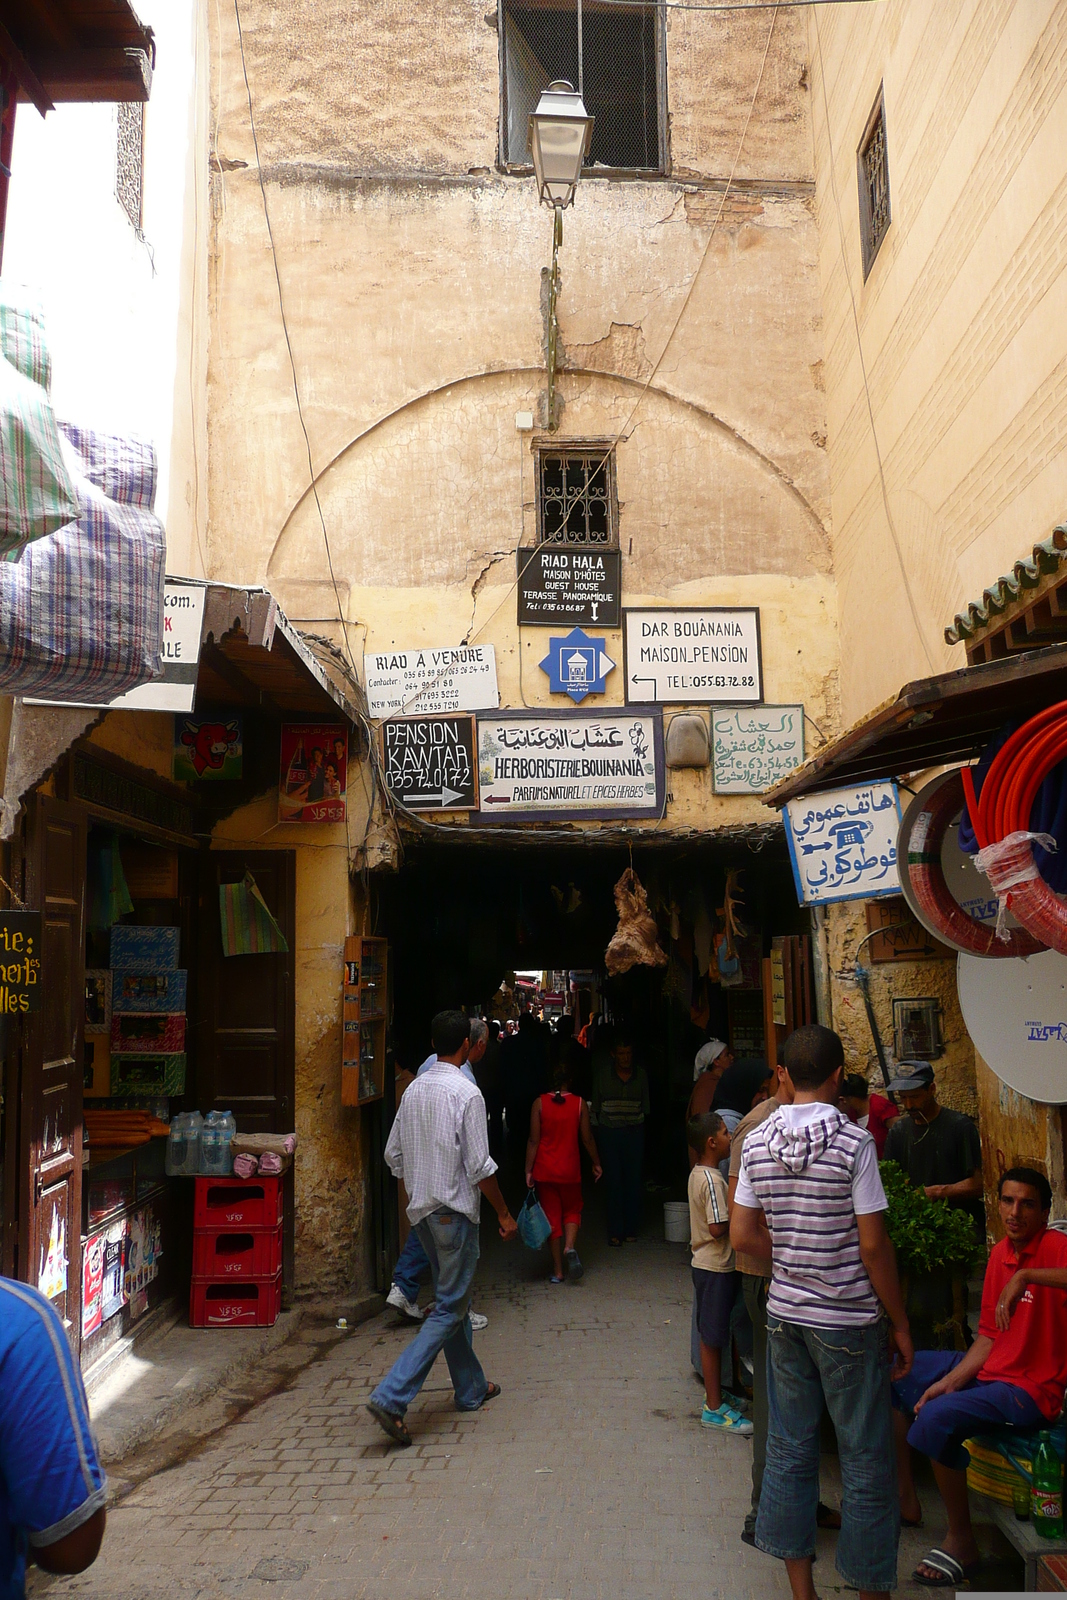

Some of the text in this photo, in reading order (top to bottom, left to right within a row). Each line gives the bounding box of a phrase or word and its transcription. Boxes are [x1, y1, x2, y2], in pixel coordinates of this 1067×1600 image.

[541, 554, 604, 569] RIAD HALA
[543, 570, 571, 580] MAISON
[545, 582, 599, 591] GUEST HOUSE
[523, 591, 613, 602] TERASSE PANORAMIQUE
[642, 622, 669, 637] DAR
[375, 648, 483, 671] RIAD A VENDRE
[371, 700, 386, 709] NEW
[715, 712, 794, 736] العشاب
[386, 721, 459, 746] PENSION
[388, 745, 471, 771] KAWTAR
[793, 790, 893, 842] هاتف عمومي
